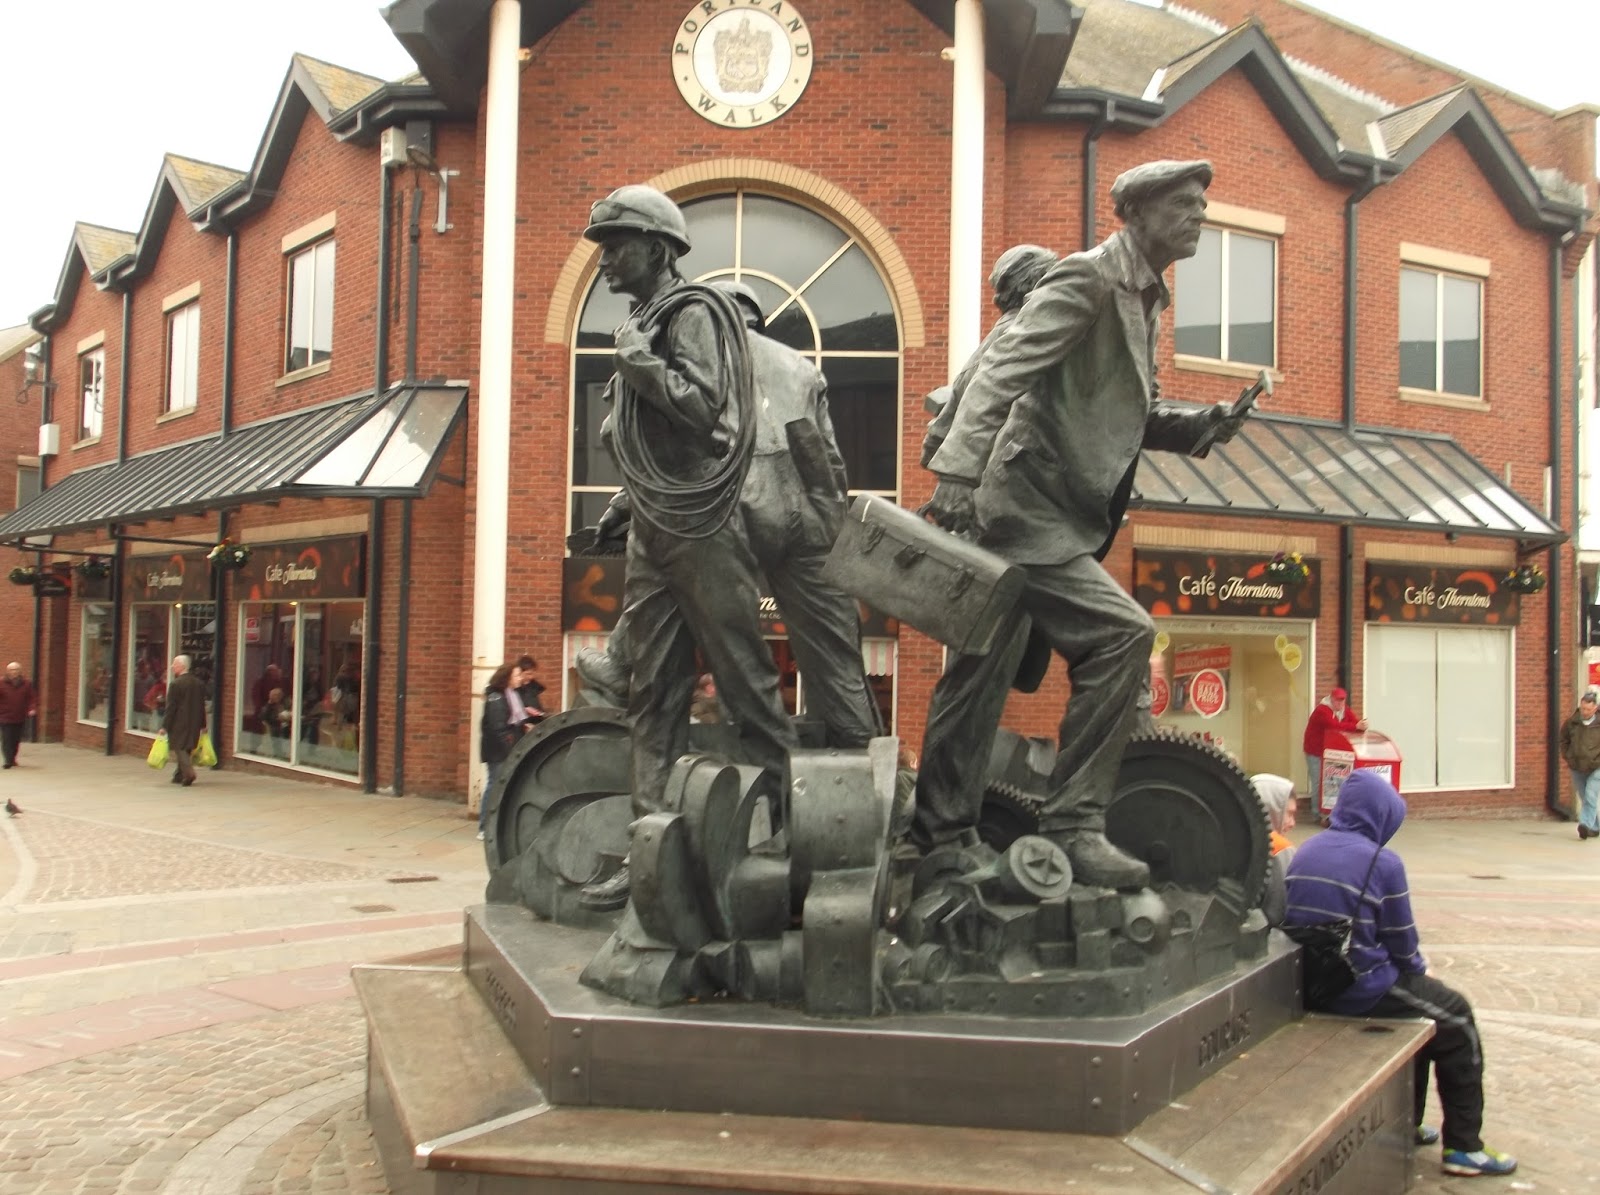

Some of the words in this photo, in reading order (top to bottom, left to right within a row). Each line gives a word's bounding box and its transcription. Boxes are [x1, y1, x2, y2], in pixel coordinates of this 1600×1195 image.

[697, 93, 787, 123] WALK
[283, 563, 317, 585] Thorntons
[1219, 576, 1284, 601] Thorntons
[1437, 586, 1491, 609] Thorntons
